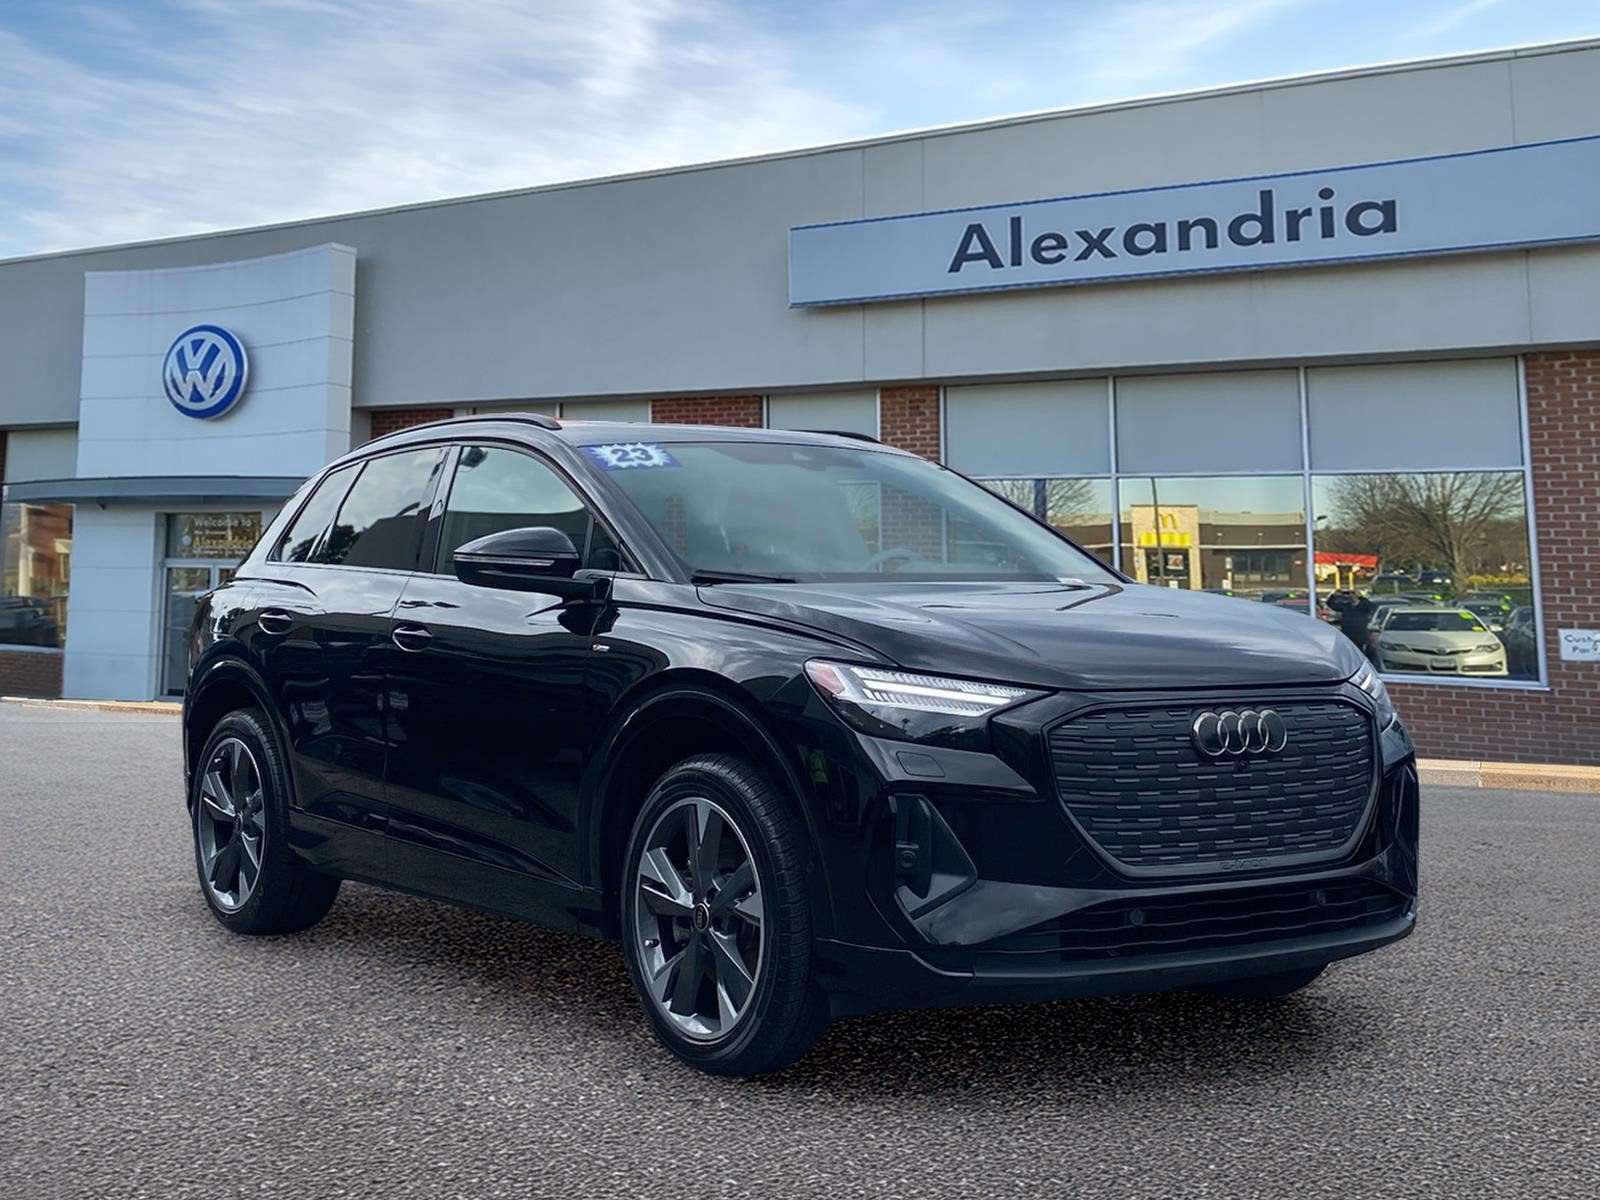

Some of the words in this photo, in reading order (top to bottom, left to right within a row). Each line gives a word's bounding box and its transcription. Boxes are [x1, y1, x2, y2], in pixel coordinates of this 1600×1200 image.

[947, 186, 1399, 273] Alexandria
[166, 332, 237, 409] VW
[610, 447, 654, 463] 23
